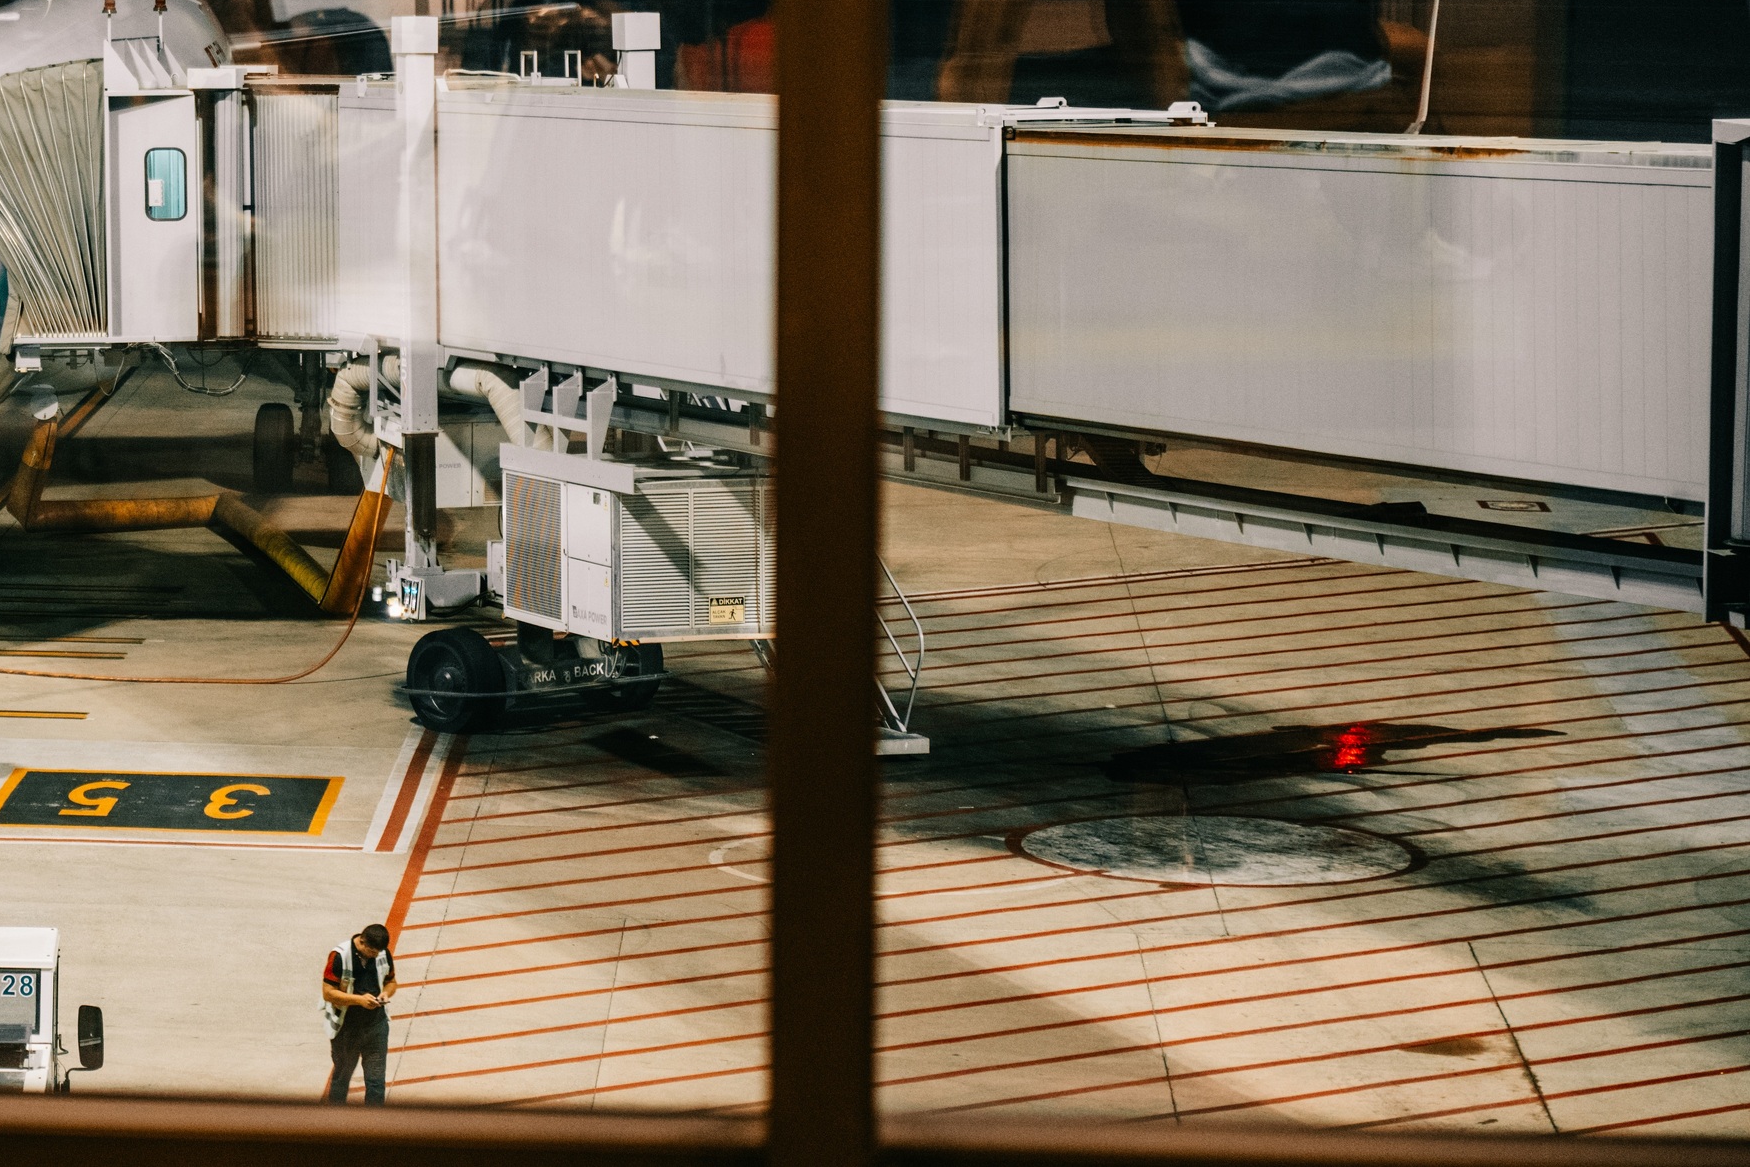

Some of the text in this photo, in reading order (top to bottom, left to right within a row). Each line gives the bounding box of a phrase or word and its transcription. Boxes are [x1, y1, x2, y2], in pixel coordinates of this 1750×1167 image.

[588, 611, 608, 626] POWER
[574, 663, 604, 678] BACK
[1, 974, 34, 997] 28
